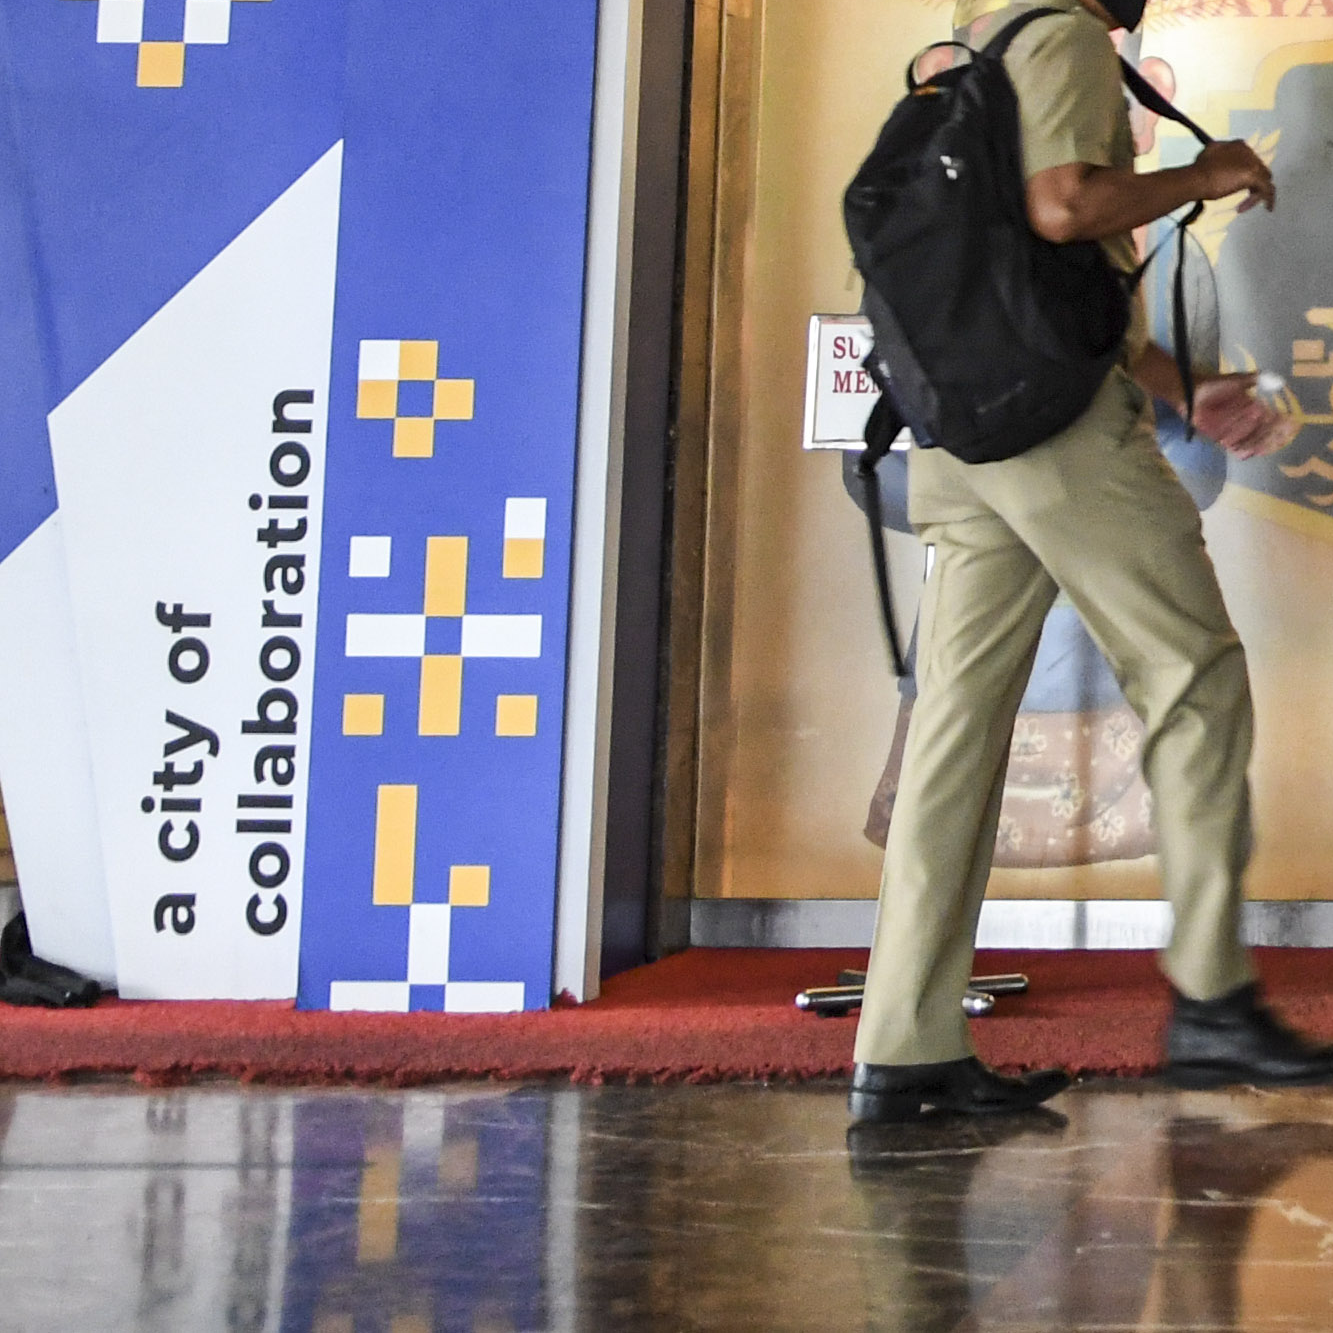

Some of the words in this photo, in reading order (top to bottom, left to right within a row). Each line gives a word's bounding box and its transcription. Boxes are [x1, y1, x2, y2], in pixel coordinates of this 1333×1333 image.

[155, 600, 212, 685] of
[235, 388, 315, 936] collaboration
[141, 709, 220, 862] city
[154, 893, 197, 935] a
